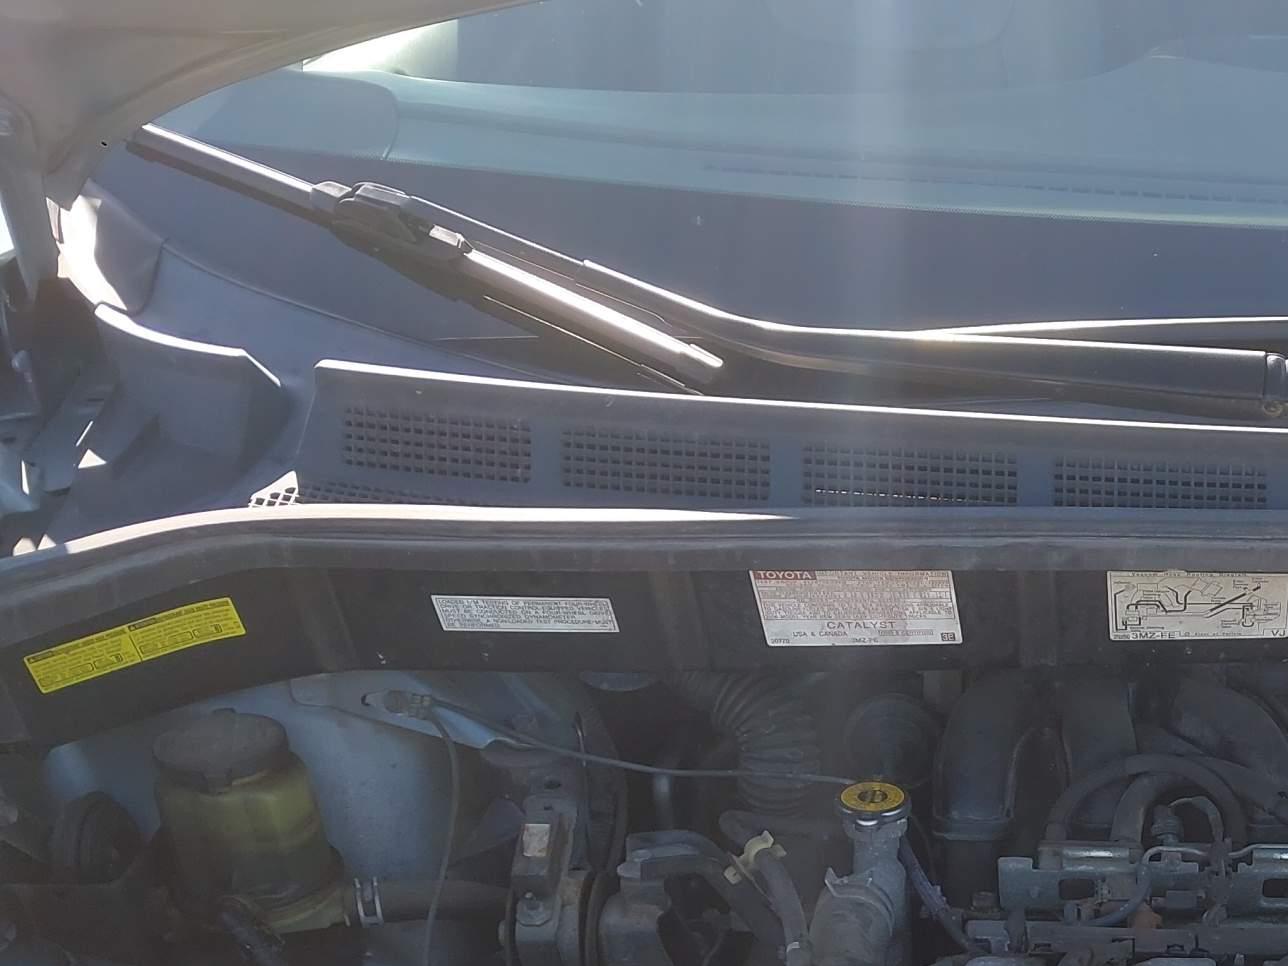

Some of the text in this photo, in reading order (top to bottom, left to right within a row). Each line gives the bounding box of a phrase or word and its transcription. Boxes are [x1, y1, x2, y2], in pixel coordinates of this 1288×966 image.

[758, 570, 811, 579] TOYOTA
[826, 621, 896, 630] CATALYST
[1271, 629, 1286, 637] VJ
